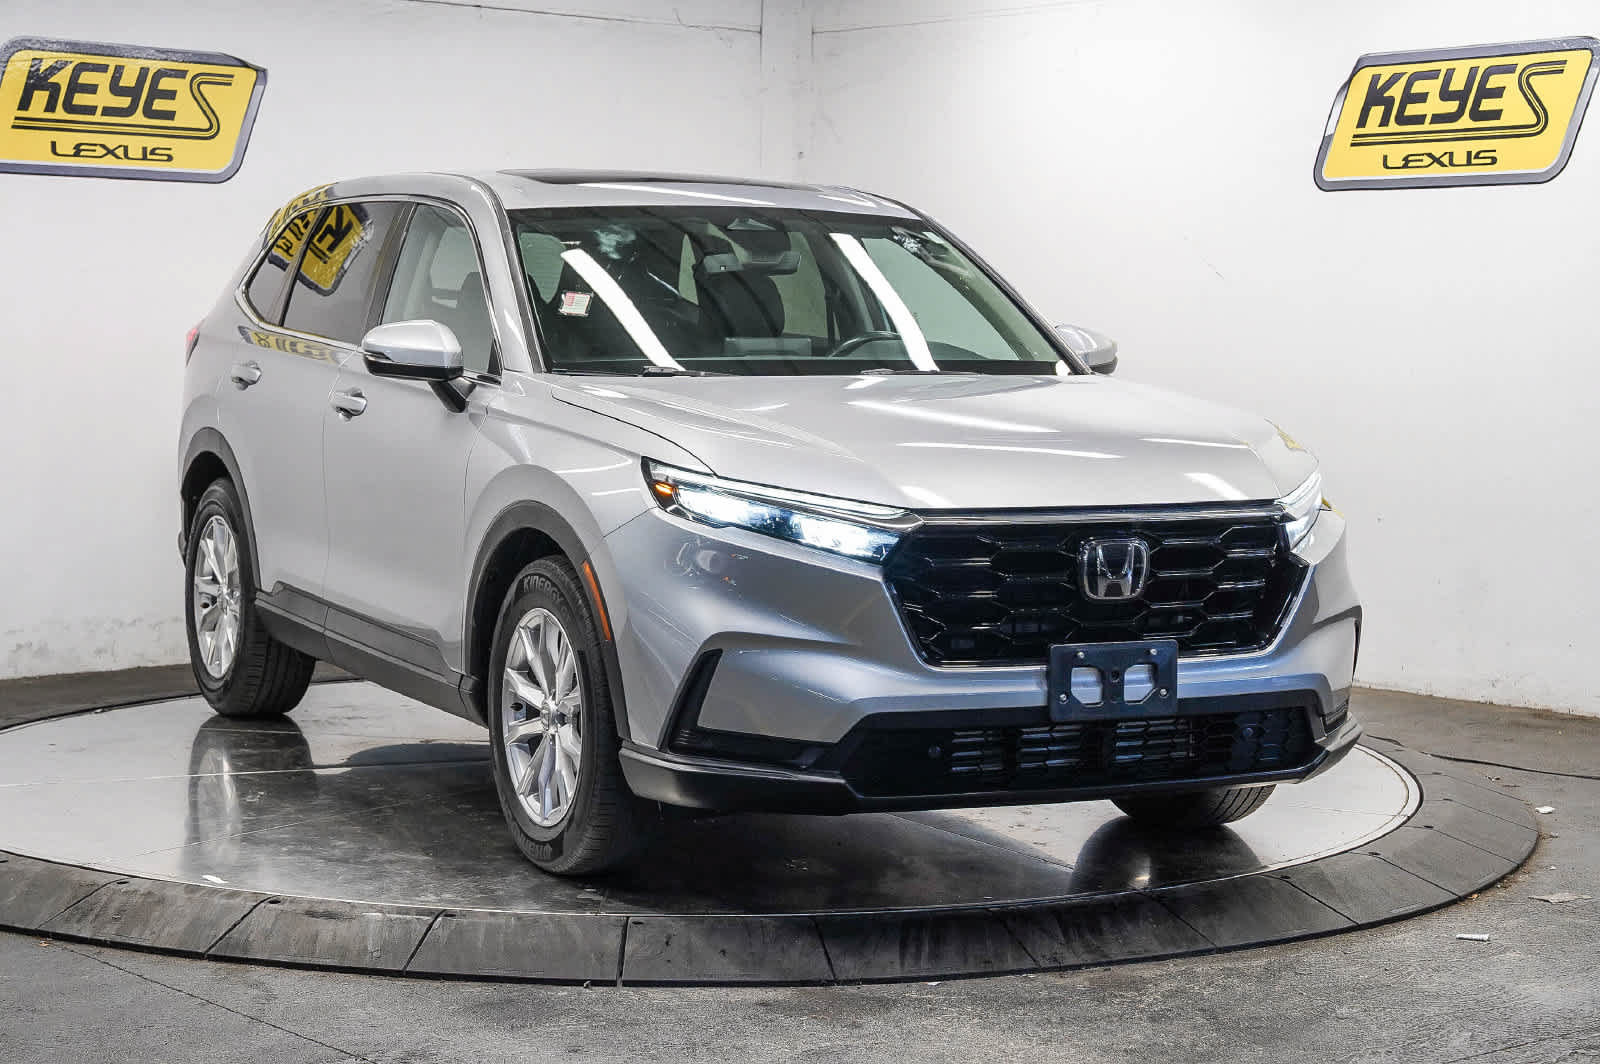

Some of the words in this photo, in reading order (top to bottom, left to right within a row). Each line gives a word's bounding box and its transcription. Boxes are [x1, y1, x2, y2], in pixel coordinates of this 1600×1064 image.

[11, 58, 235, 140] KEYES
[1350, 60, 1568, 147] KEYES
[50, 140, 174, 162] LEXUS
[1382, 149, 1498, 170] LEXUS
